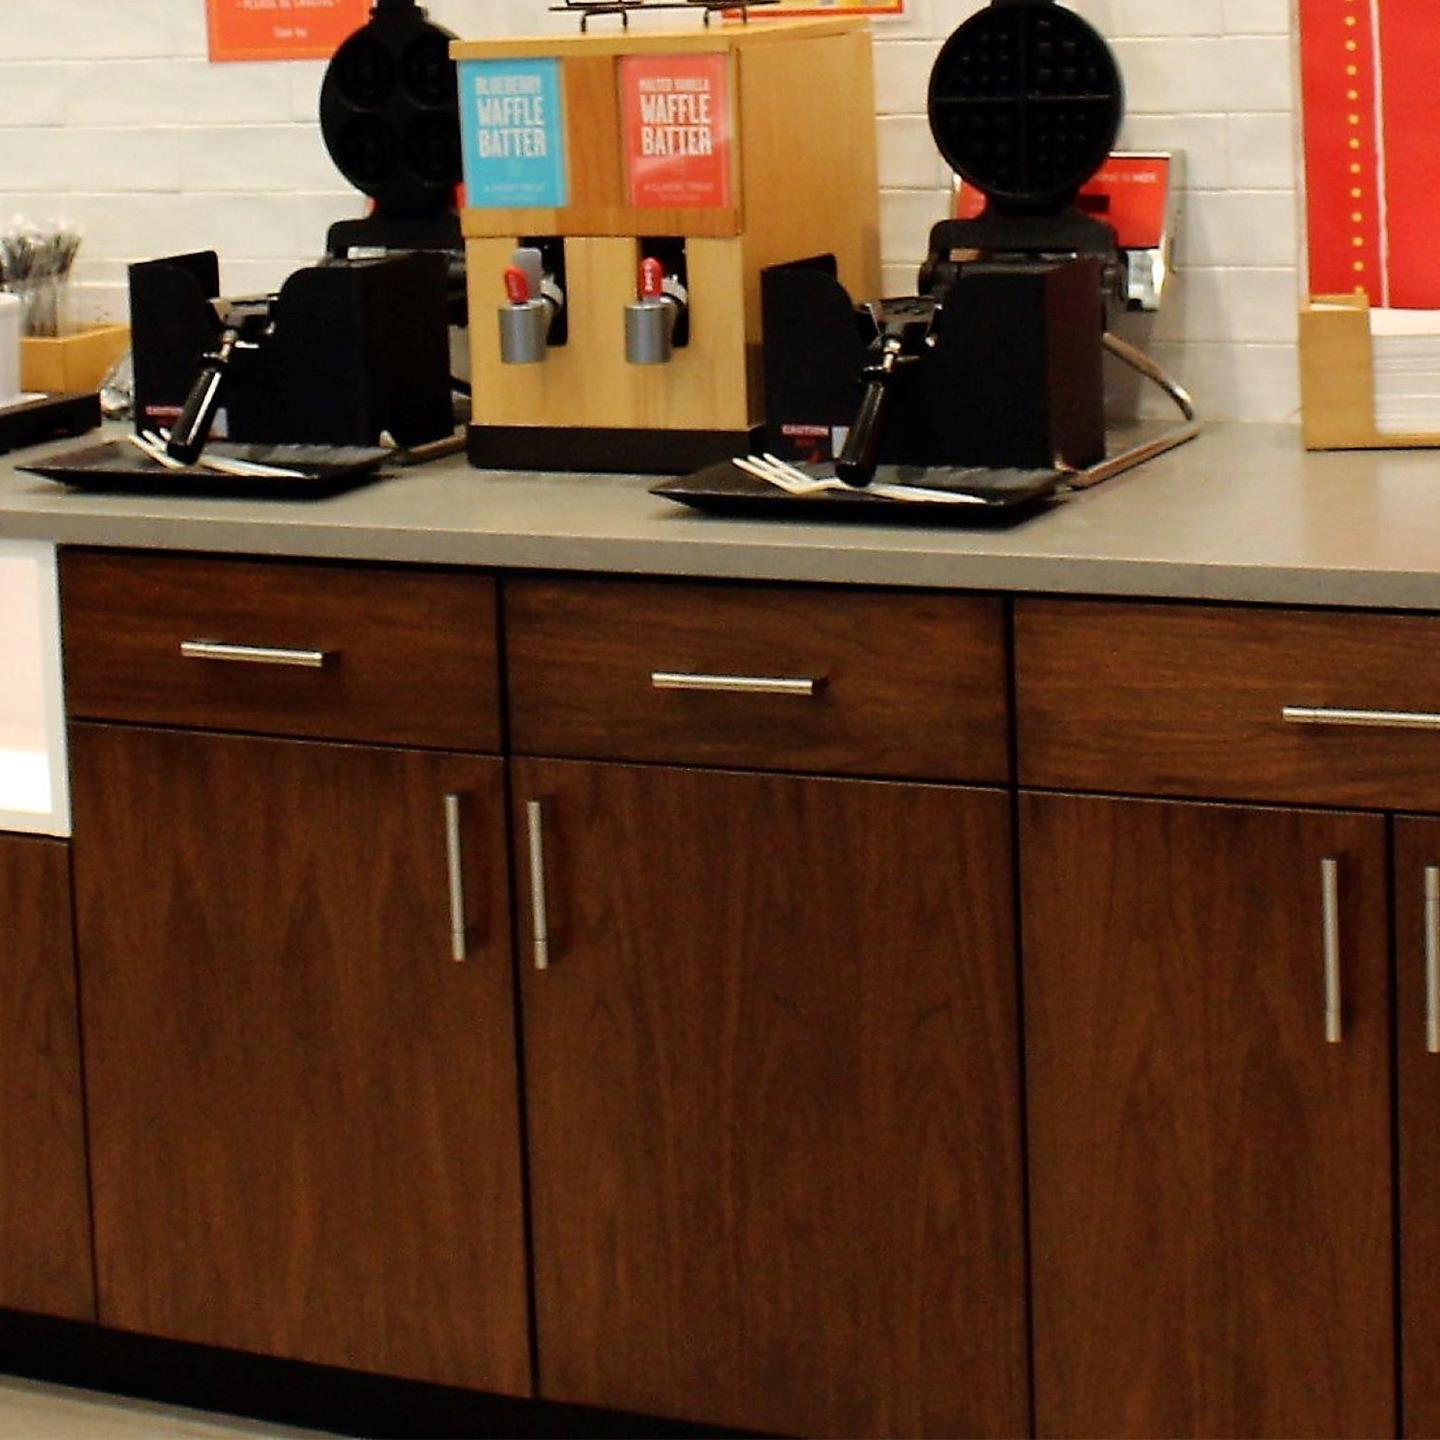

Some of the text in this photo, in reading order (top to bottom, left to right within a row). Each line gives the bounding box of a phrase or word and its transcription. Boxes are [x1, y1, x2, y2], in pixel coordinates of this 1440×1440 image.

[476, 95, 545, 126] WAFFLE
[640, 94, 711, 124] WAFFLE
[478, 126, 547, 158] BATTER
[641, 126, 713, 156] BATTER
